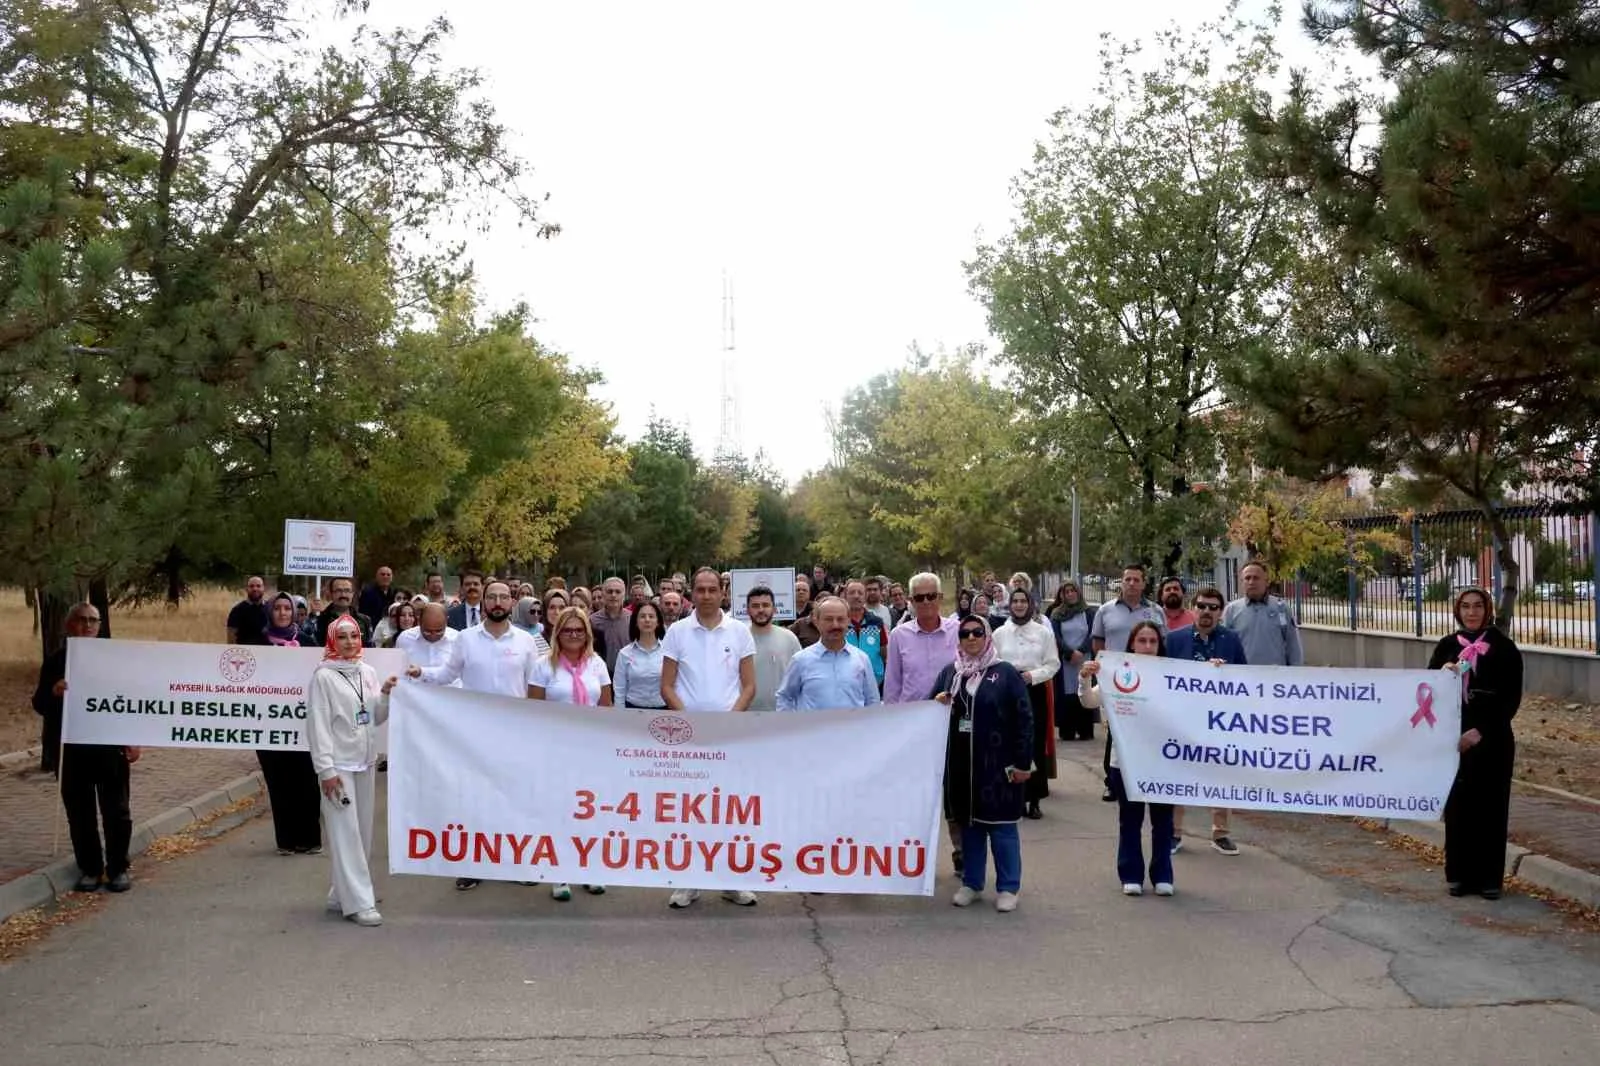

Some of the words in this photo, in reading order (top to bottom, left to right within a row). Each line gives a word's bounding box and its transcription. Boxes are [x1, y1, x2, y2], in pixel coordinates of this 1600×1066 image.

[214, 684, 246, 694] SAĞLIK
[1164, 675, 1250, 697] TARAMA
[1255, 683, 1264, 698] 1
[1272, 682, 1382, 704] SAATİNİZİ,
[86, 695, 174, 715] SAĞLIKLI
[181, 701, 262, 721] BESLEN,
[268, 700, 308, 720] SAĞ
[171, 727, 263, 744] HAREKET
[269, 730, 299, 745] ET!
[1208, 710, 1333, 737] KANSER
[634, 748, 669, 759] SAĞLIK
[671, 750, 726, 761] BAKANLIĞI
[1162, 738, 1311, 771] ÖMRÜNÜZÜ
[1318, 754, 1384, 772] ALIR.
[573, 790, 641, 823] 3-4
[655, 787, 761, 826] EKİM
[1137, 780, 1199, 797] KAYSERİ
[1203, 784, 1262, 802] VALİLİĞİ
[1266, 787, 1279, 803] İL
[1283, 791, 1339, 807] SAĞLIK
[1342, 793, 1440, 812] MÜDÜRLÜĞÜ
[408, 824, 559, 866] DÜNYA
[573, 831, 783, 881] YÜRÜYÜŞ
[796, 837, 926, 878] GÜNÜ
